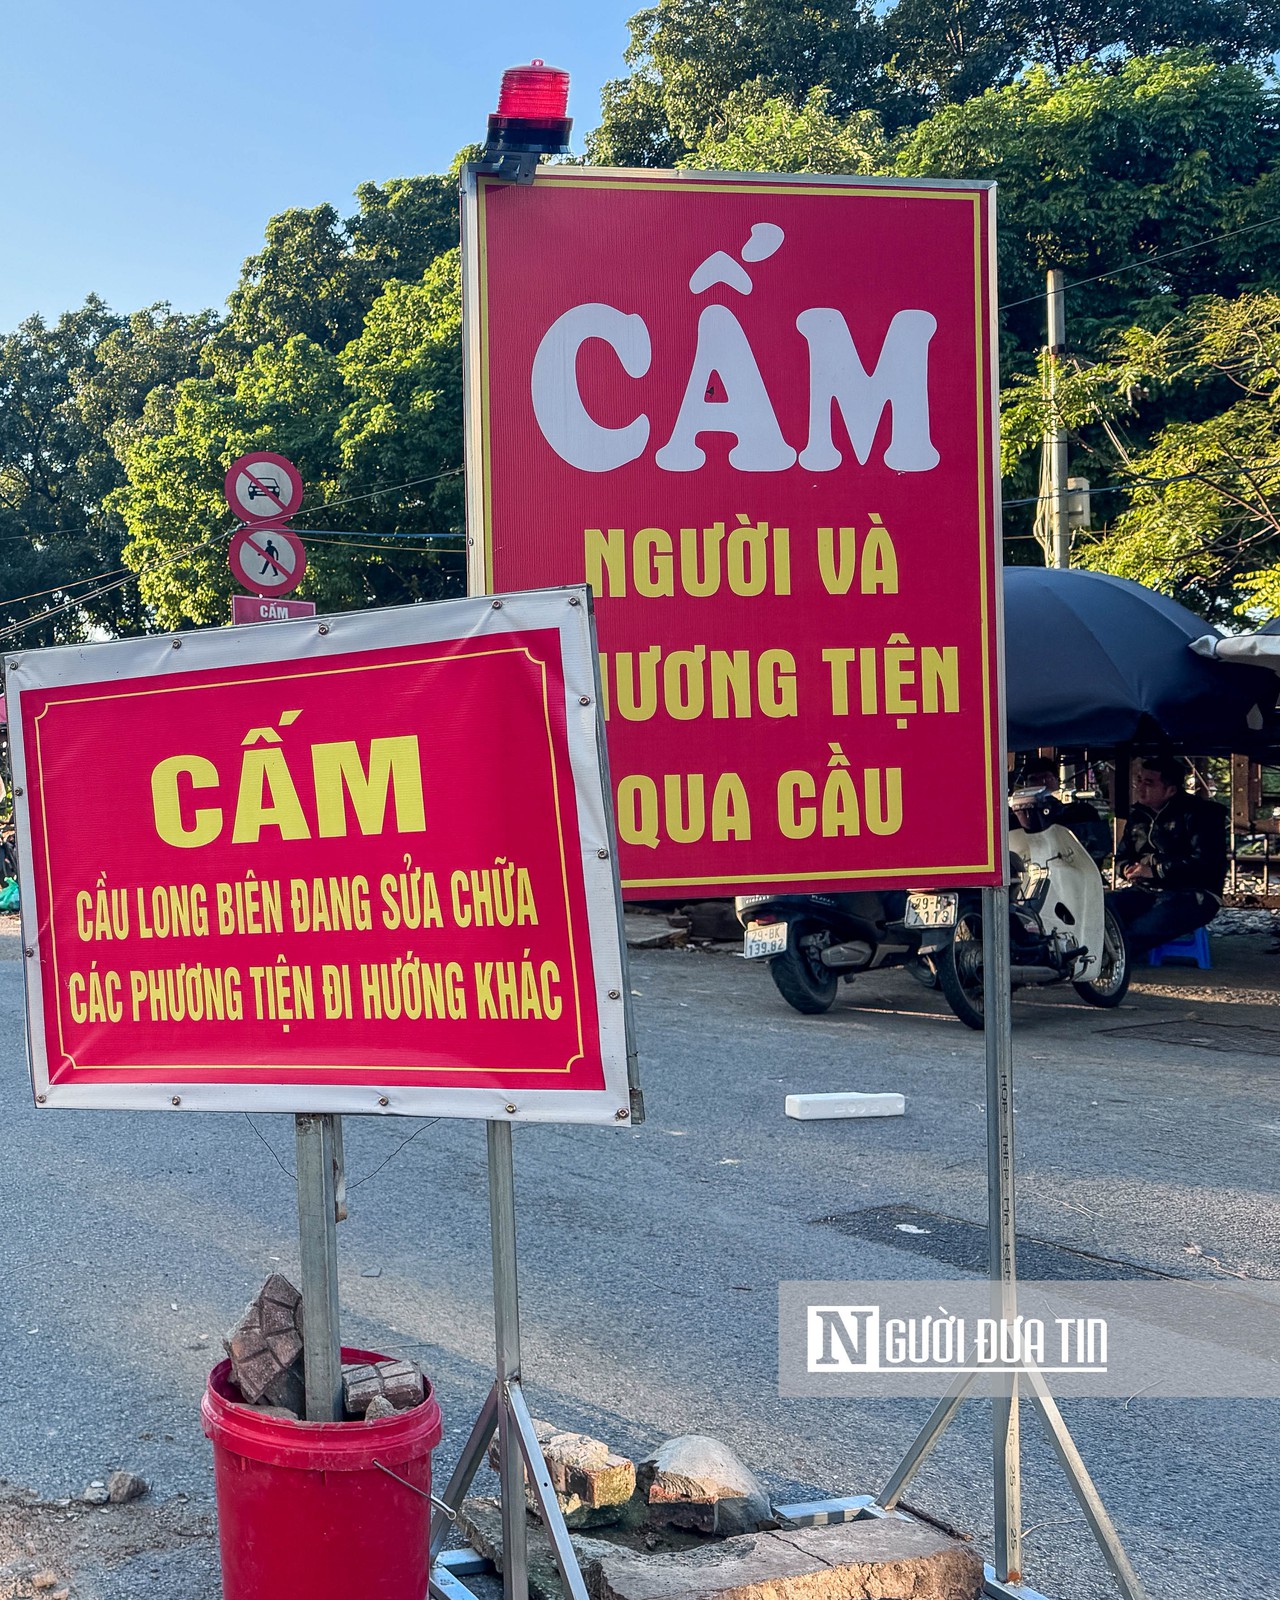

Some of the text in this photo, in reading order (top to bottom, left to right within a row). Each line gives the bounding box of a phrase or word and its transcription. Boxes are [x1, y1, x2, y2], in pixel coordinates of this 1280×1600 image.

[531, 222, 941, 472] CẤM
[584, 512, 898, 598] NGƯỜI VÀ
[260, 602, 289, 619] CẤM
[823, 633, 960, 728] TIỆN
[151, 709, 426, 848] CẤM
[617, 742, 903, 849] QUA CẦU
[76, 853, 539, 941] CẦU LONG BIÊN ĐANG SỬA CHỮA
[68, 948, 563, 1033] CÁC PHƯƠNG TIỆN ĐI HƯỚNG KHÁC
[748, 938, 785, 956] 139.82
